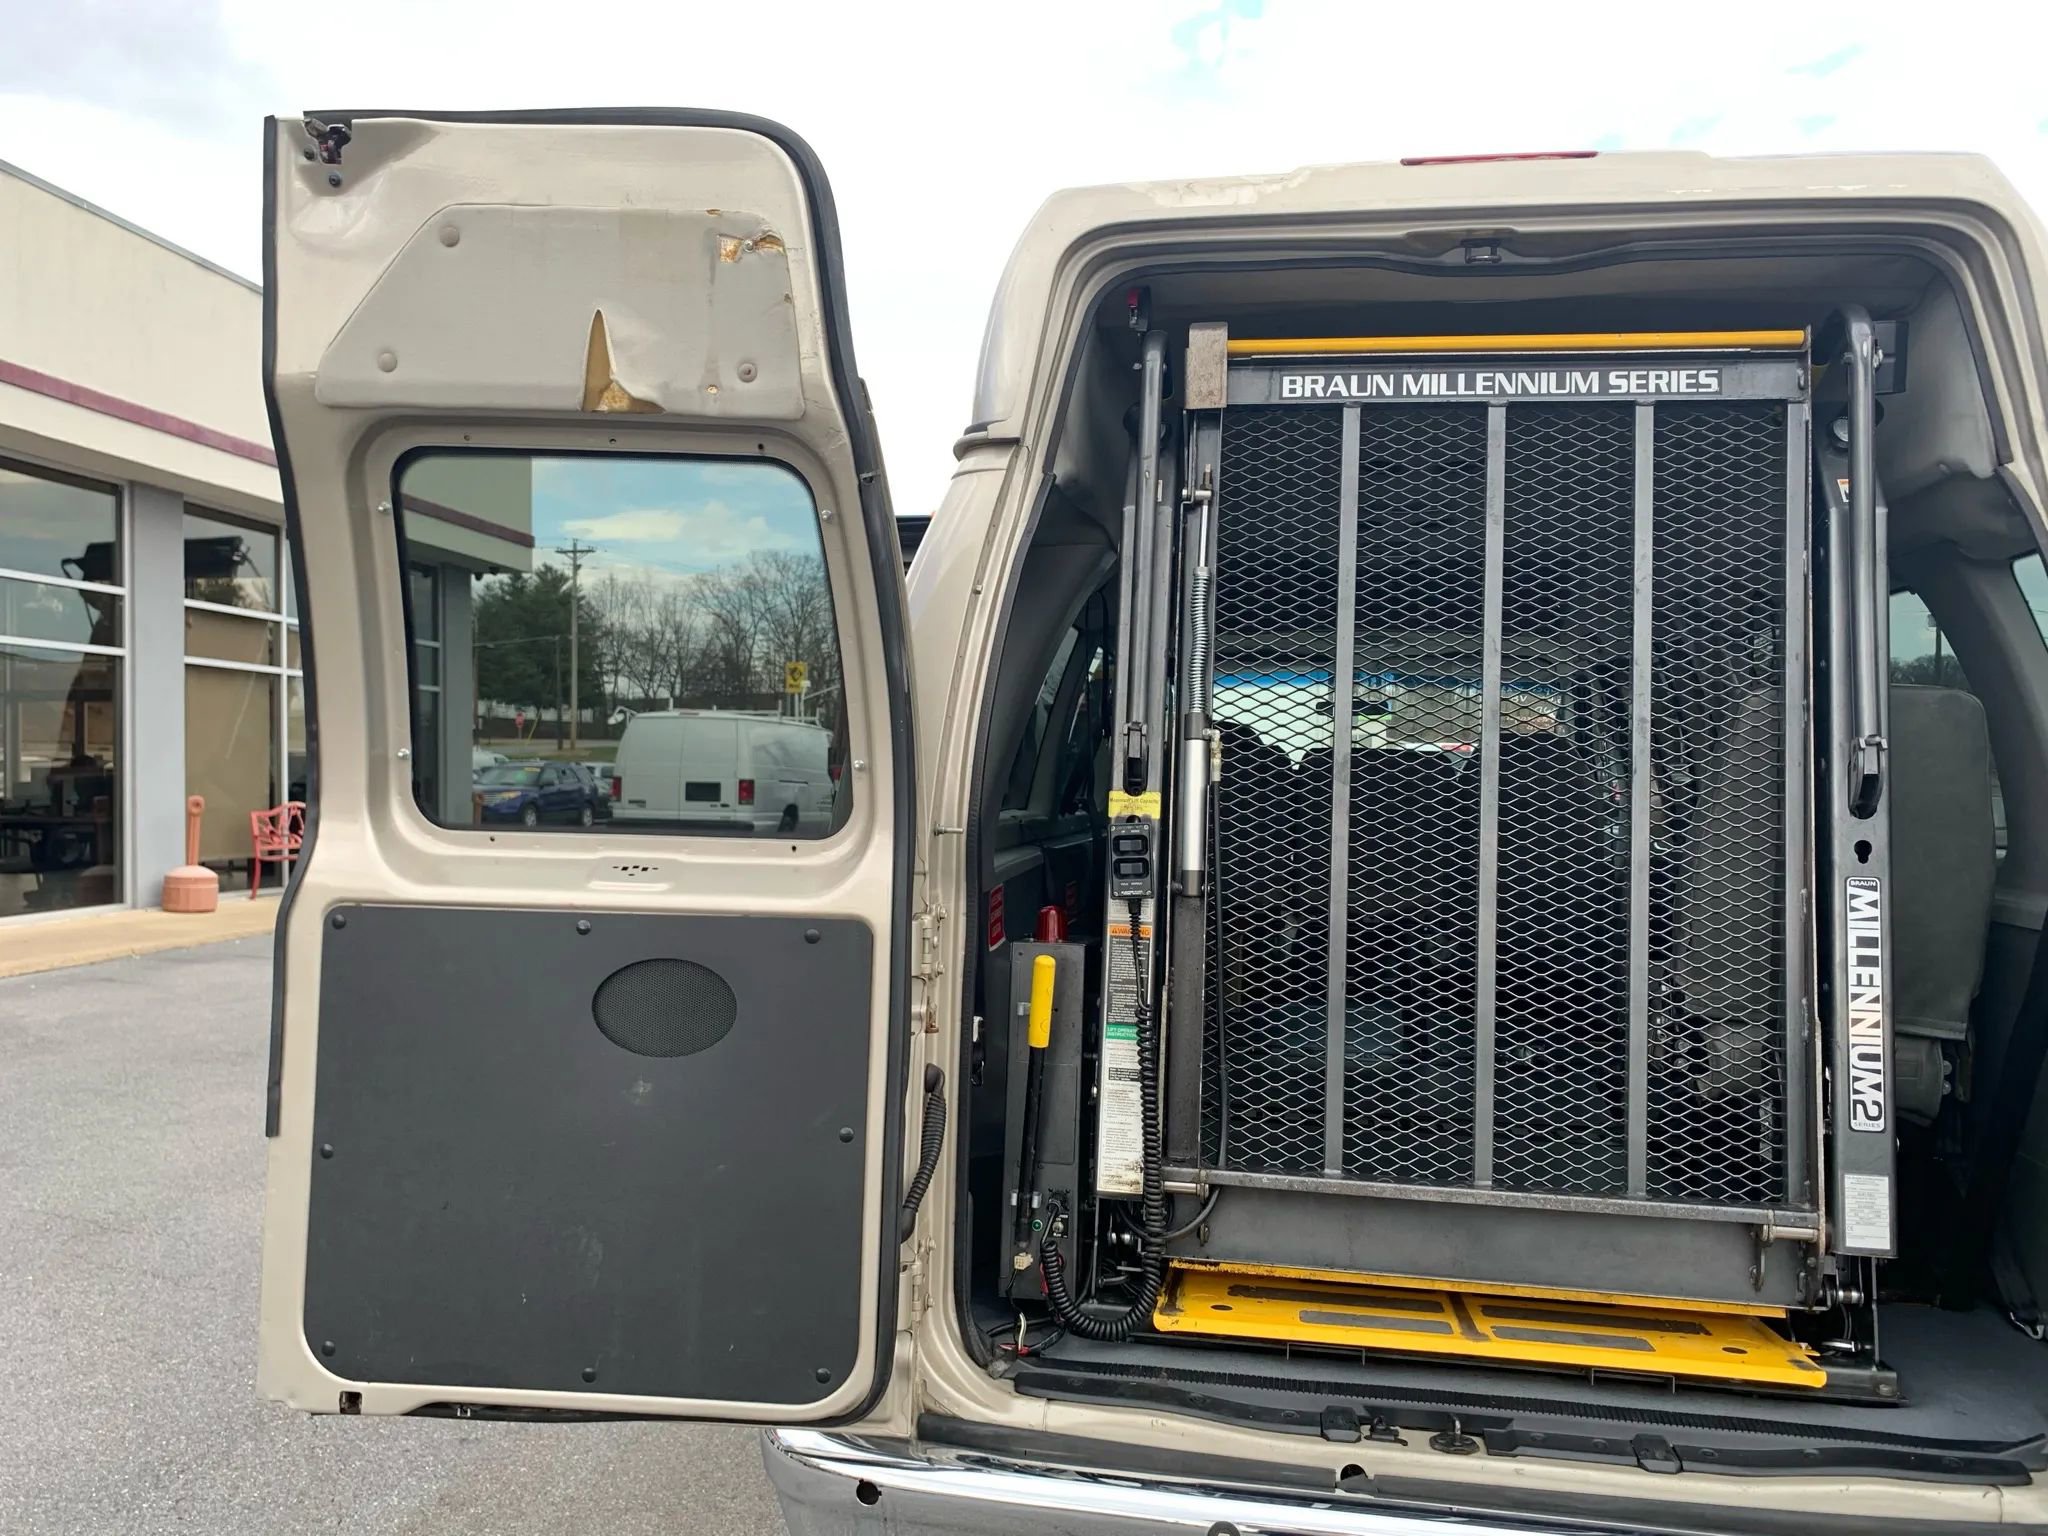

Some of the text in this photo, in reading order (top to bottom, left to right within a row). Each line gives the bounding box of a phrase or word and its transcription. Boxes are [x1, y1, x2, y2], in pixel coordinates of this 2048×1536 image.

[1282, 369, 1719, 398] BRAUN MILLENNIUM SERIES
